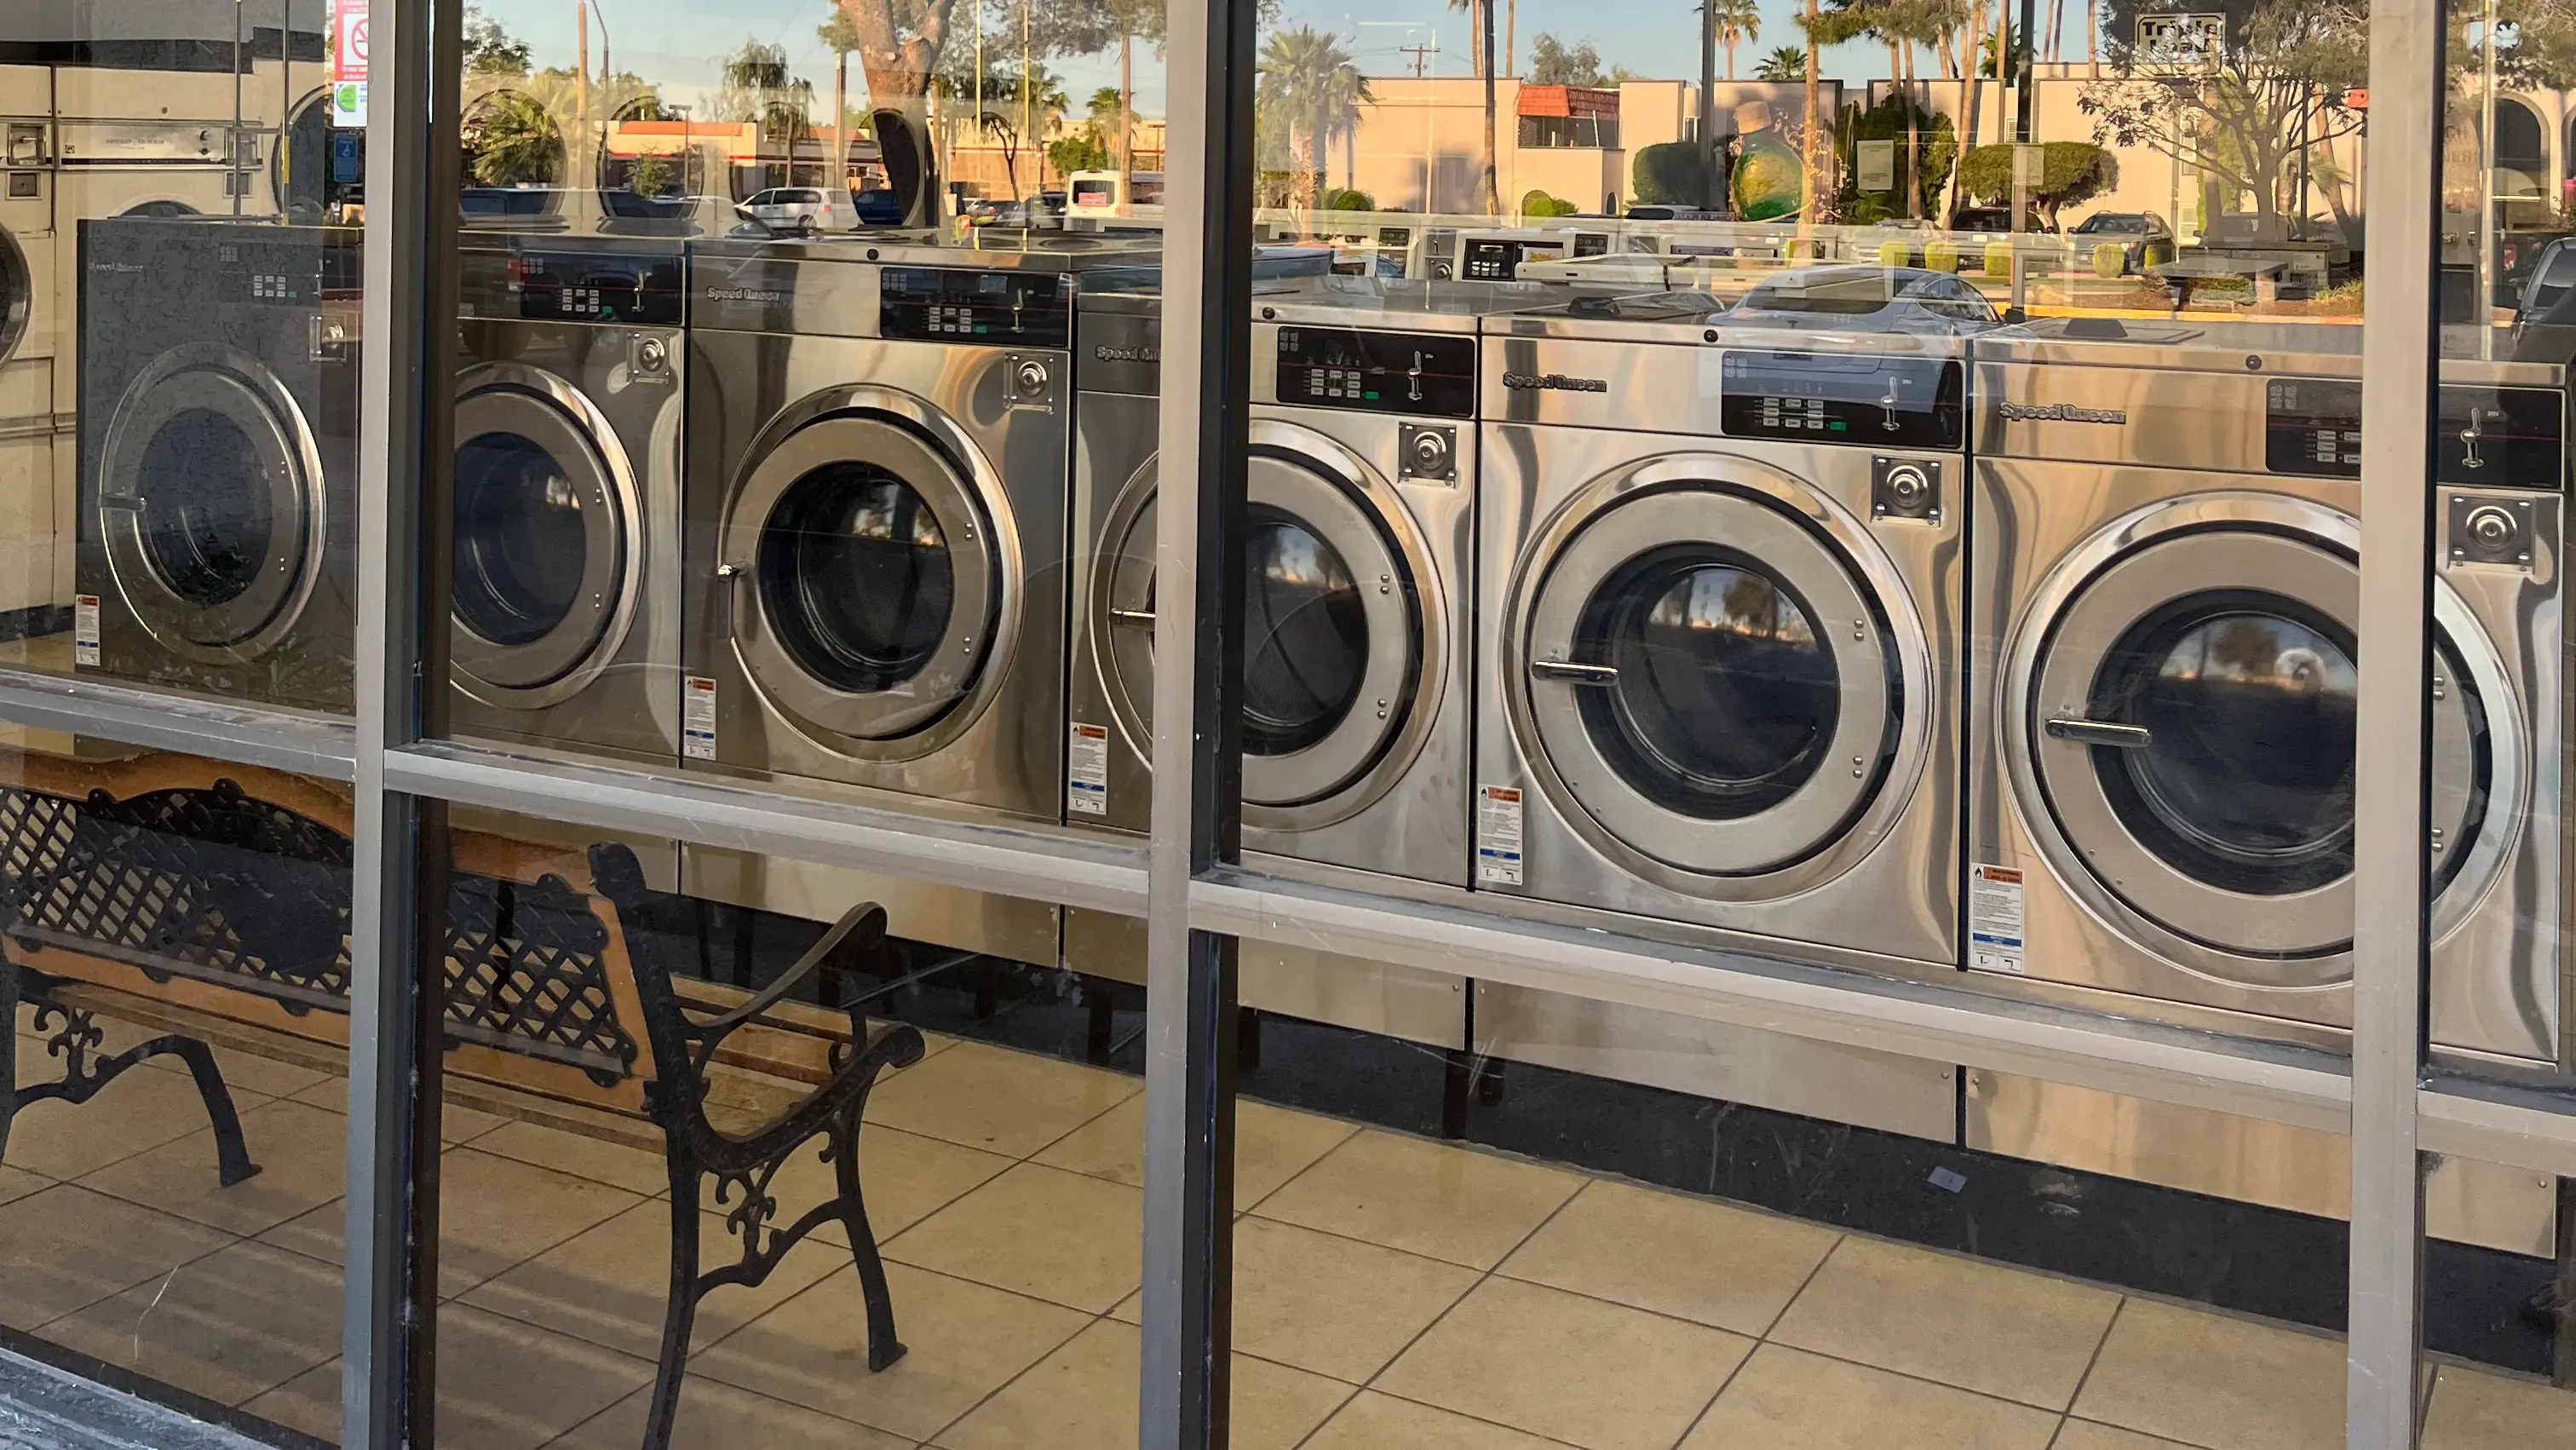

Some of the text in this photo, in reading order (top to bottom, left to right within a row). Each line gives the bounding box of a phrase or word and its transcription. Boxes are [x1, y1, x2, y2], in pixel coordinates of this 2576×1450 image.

[707, 286, 780, 302] Speed Queen
[1095, 345, 1138, 361] Speed
[1503, 371, 1607, 393] Speed Queen
[1999, 401, 2126, 424] Speed Queen
